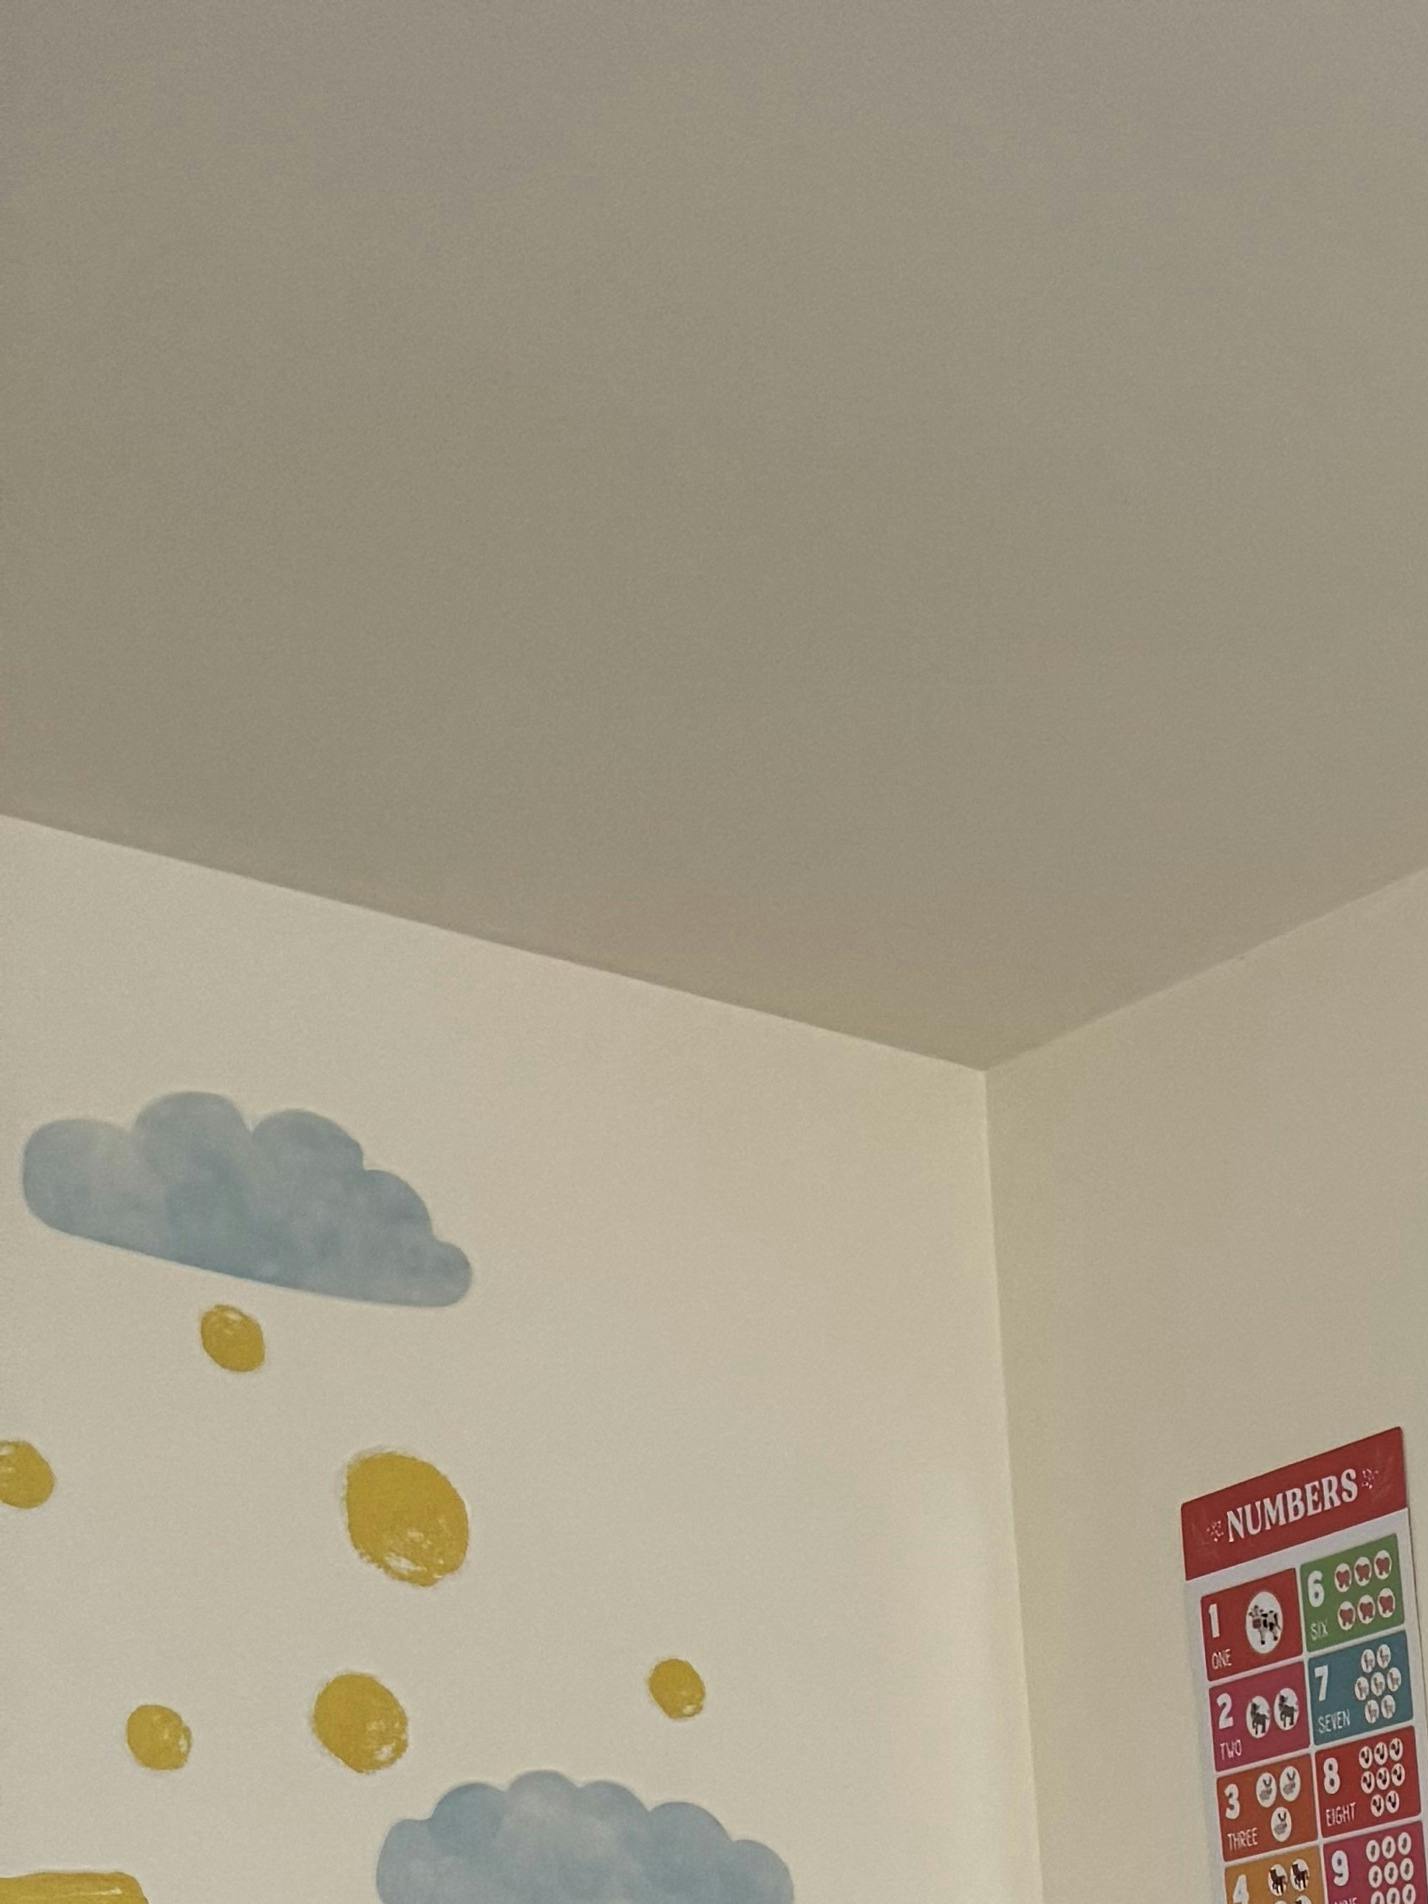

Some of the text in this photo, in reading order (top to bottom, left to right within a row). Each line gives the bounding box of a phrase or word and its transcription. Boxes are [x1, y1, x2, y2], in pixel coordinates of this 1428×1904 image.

[1226, 1468, 1358, 1543] NUMBERS
[1307, 1570, 1325, 1608] 6
[1208, 1603, 1220, 1638] 1
[1310, 1621, 1329, 1641] SIX
[1211, 1648, 1233, 1670] ONE
[1314, 1664, 1329, 1702] 7
[1216, 1692, 1234, 1730] 2
[1317, 1708, 1351, 1734] SEVEN
[1219, 1738, 1243, 1761] TWO
[1323, 1756, 1340, 1795] 8
[1223, 1783, 1241, 1820] 3
[1325, 1801, 1357, 1827] EIGHT
[1226, 1826, 1259, 1851] THREE
[1331, 1850, 1350, 1887] 9
